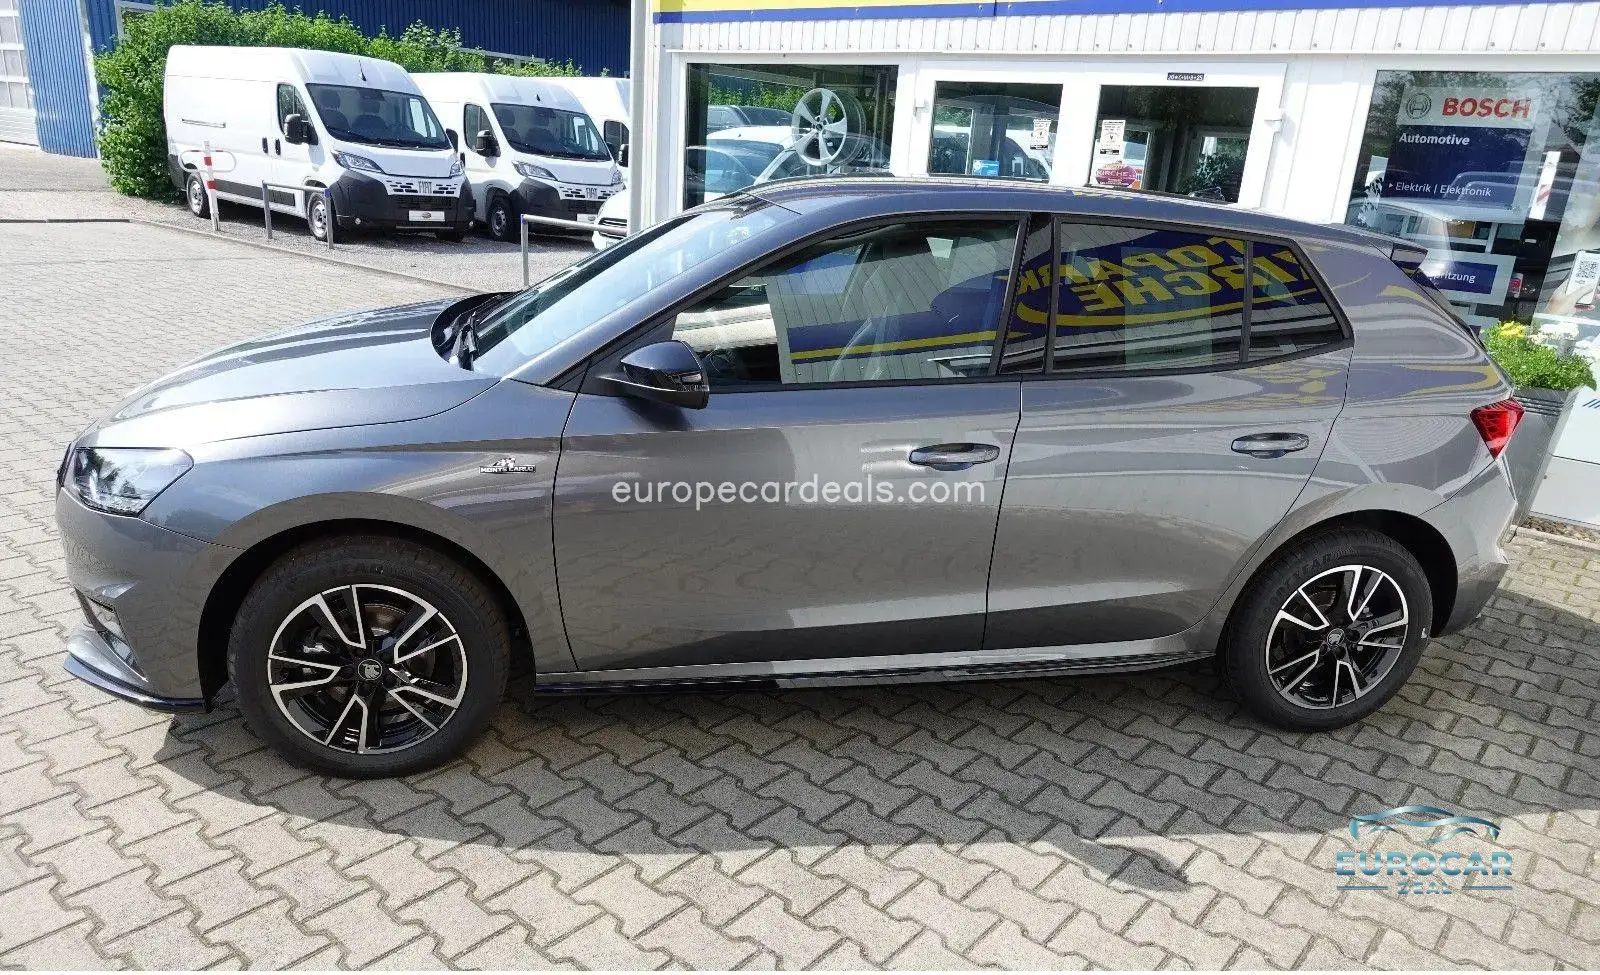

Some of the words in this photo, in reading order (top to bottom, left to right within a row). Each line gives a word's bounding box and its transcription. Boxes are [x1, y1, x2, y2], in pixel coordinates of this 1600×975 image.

[1442, 97, 1532, 118] BOSCH
[1399, 132, 1470, 146] Automotive
[418, 181, 432, 194] FIAT
[1395, 182, 1431, 193] Elektrik
[1439, 185, 1492, 197] Elektronik
